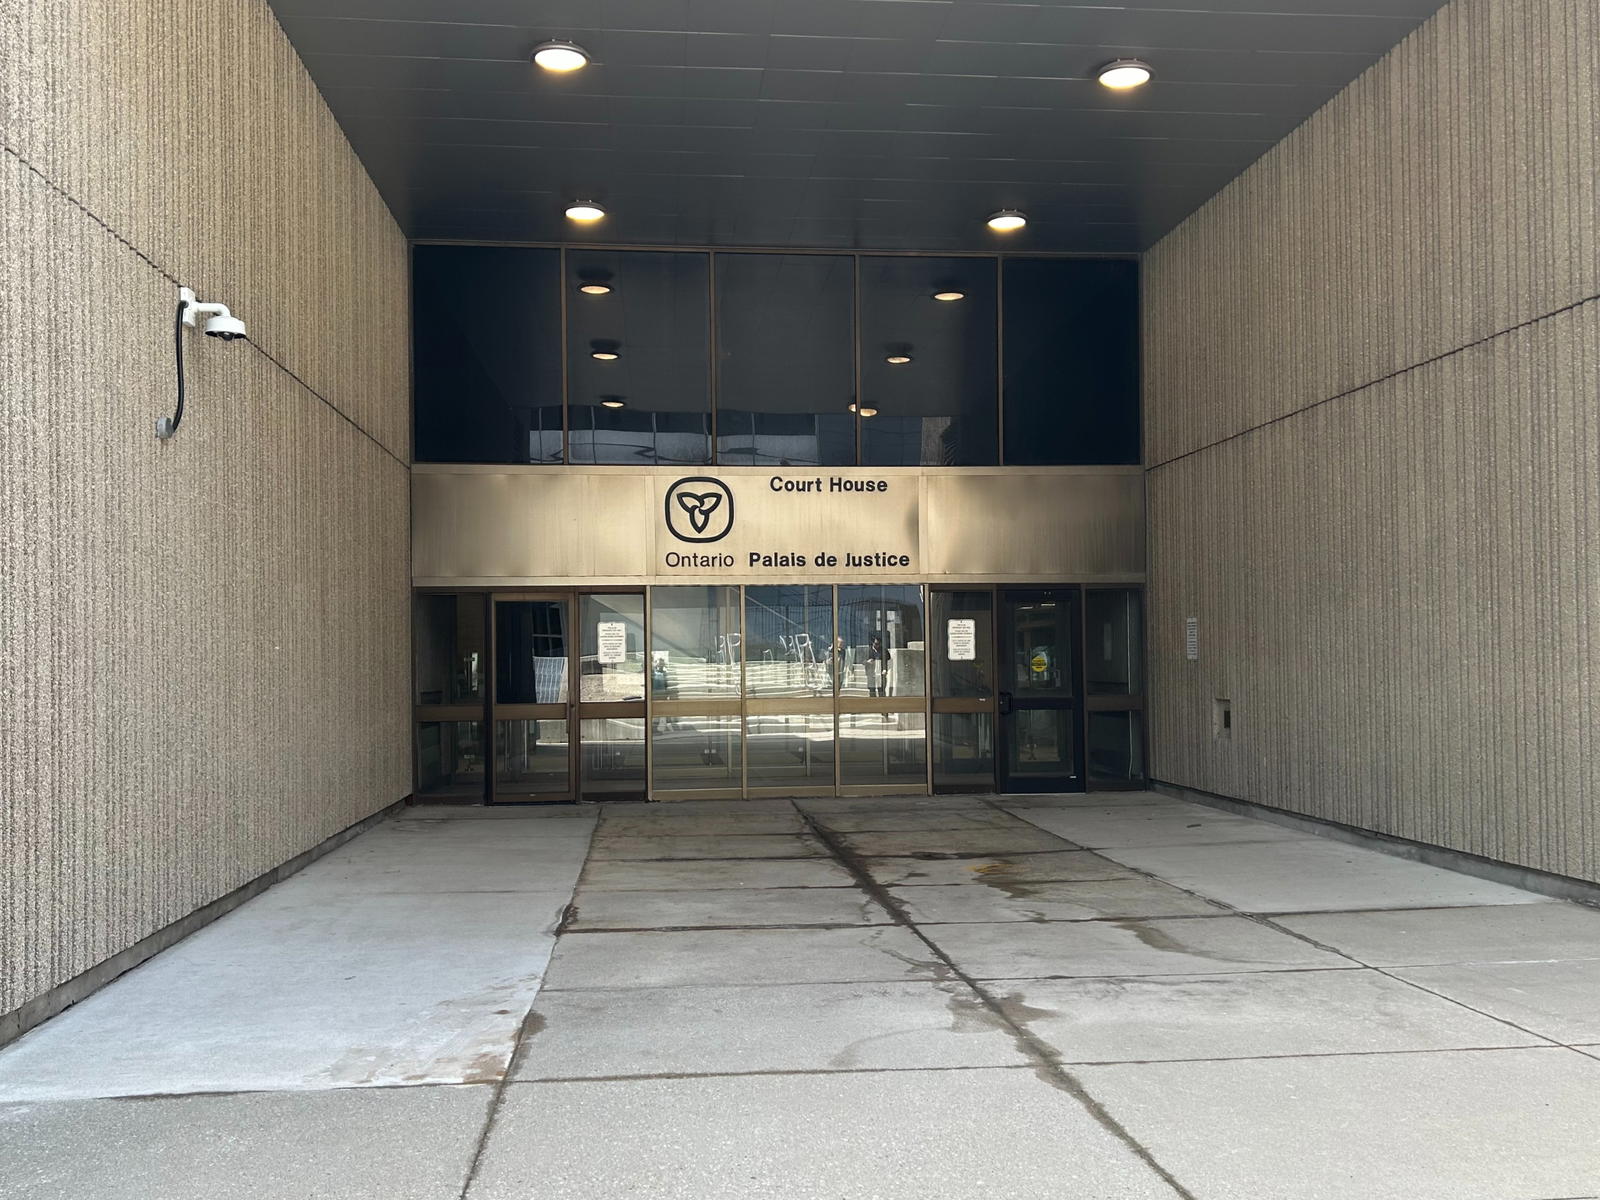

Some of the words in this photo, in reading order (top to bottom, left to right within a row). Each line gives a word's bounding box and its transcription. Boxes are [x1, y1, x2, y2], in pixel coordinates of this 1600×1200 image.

[770, 476, 822, 492] Court
[829, 476, 888, 492] House
[665, 551, 734, 568] Ontario
[749, 552, 806, 567] Palais
[814, 552, 837, 567] de
[845, 552, 910, 567] Justice
